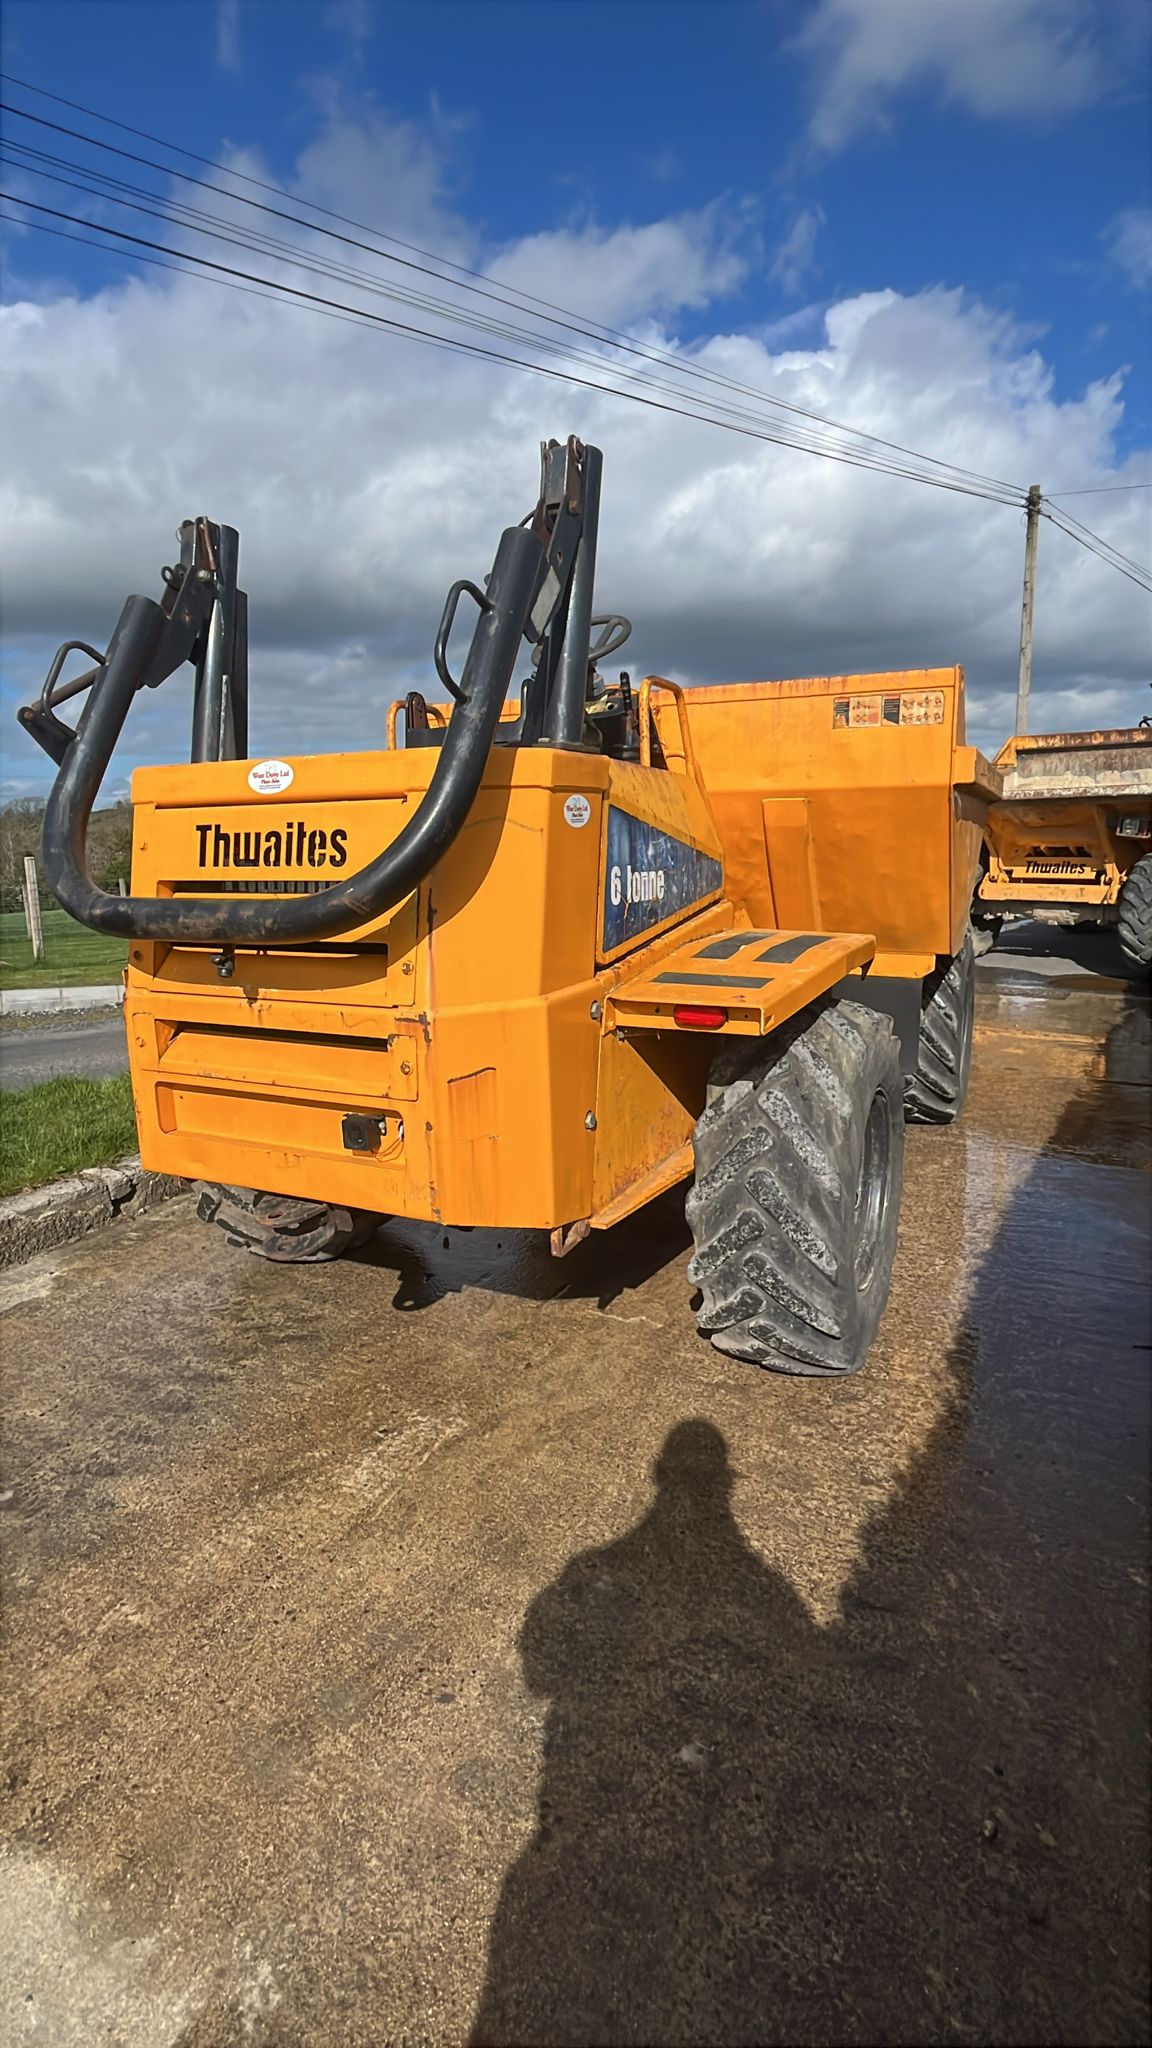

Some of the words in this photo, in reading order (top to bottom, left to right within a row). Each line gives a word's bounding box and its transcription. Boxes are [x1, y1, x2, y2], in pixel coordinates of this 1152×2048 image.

[195, 821, 348, 868] Thwaites
[610, 865, 622, 906] 6
[626, 864, 665, 903] tonne
[1025, 860, 1087, 875] Thwaites
